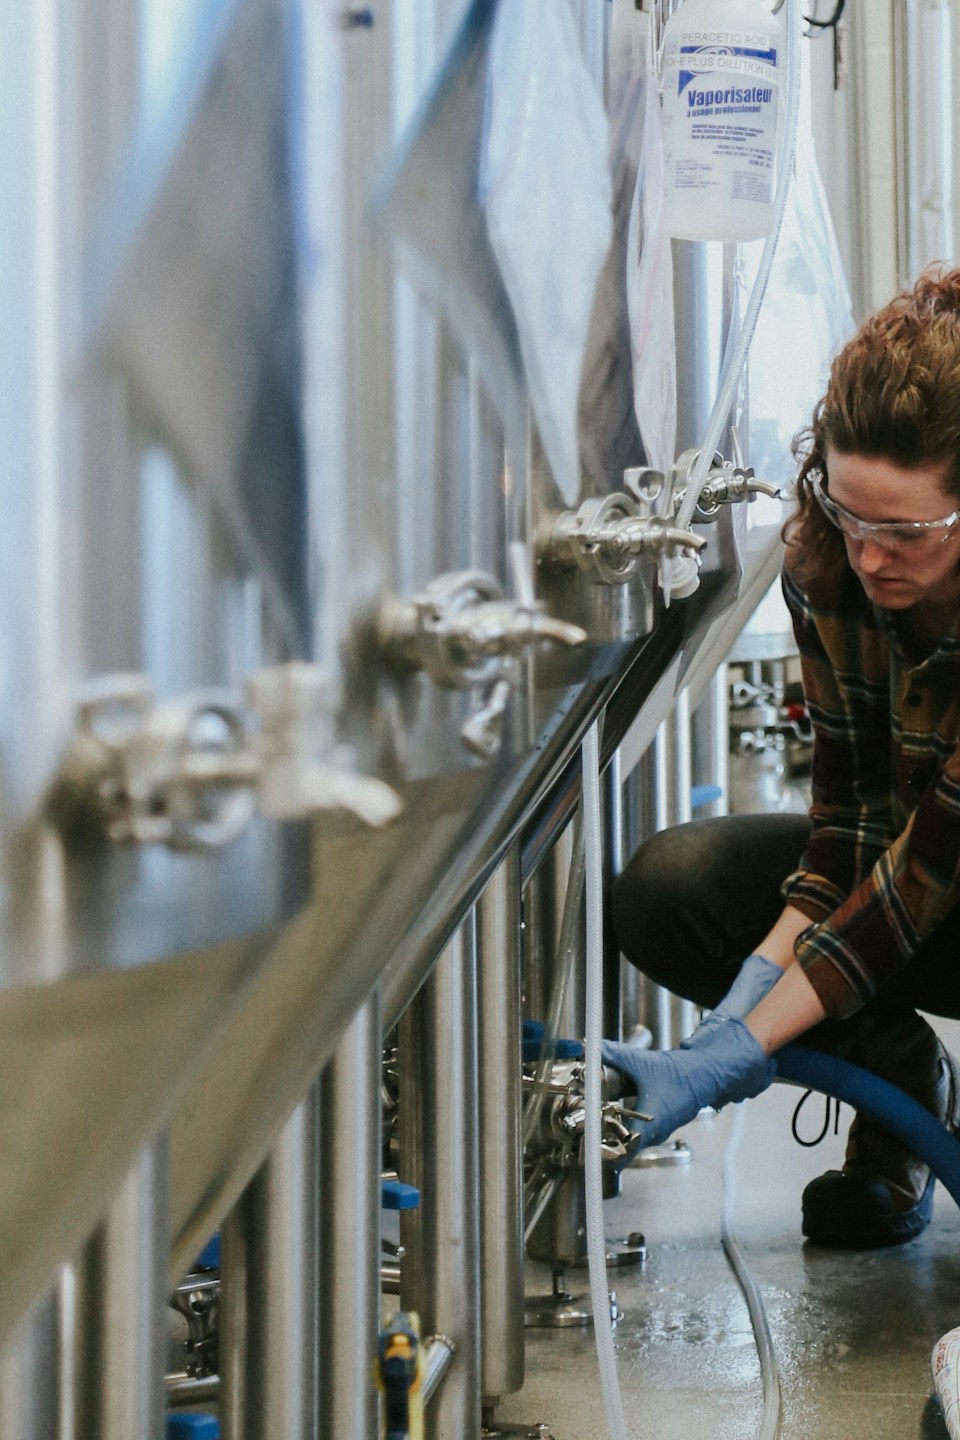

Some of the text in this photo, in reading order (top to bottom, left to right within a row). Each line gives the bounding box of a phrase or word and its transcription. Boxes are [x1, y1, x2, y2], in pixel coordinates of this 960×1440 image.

[682, 32, 767, 46] PERACETIC ACID
[687, 56, 714, 67] PLUS
[717, 58, 764, 74] DILUTION
[688, 86, 772, 107] Vaporisateur
[691, 107, 714, 117] usage
[715, 105, 761, 114] professionnel
